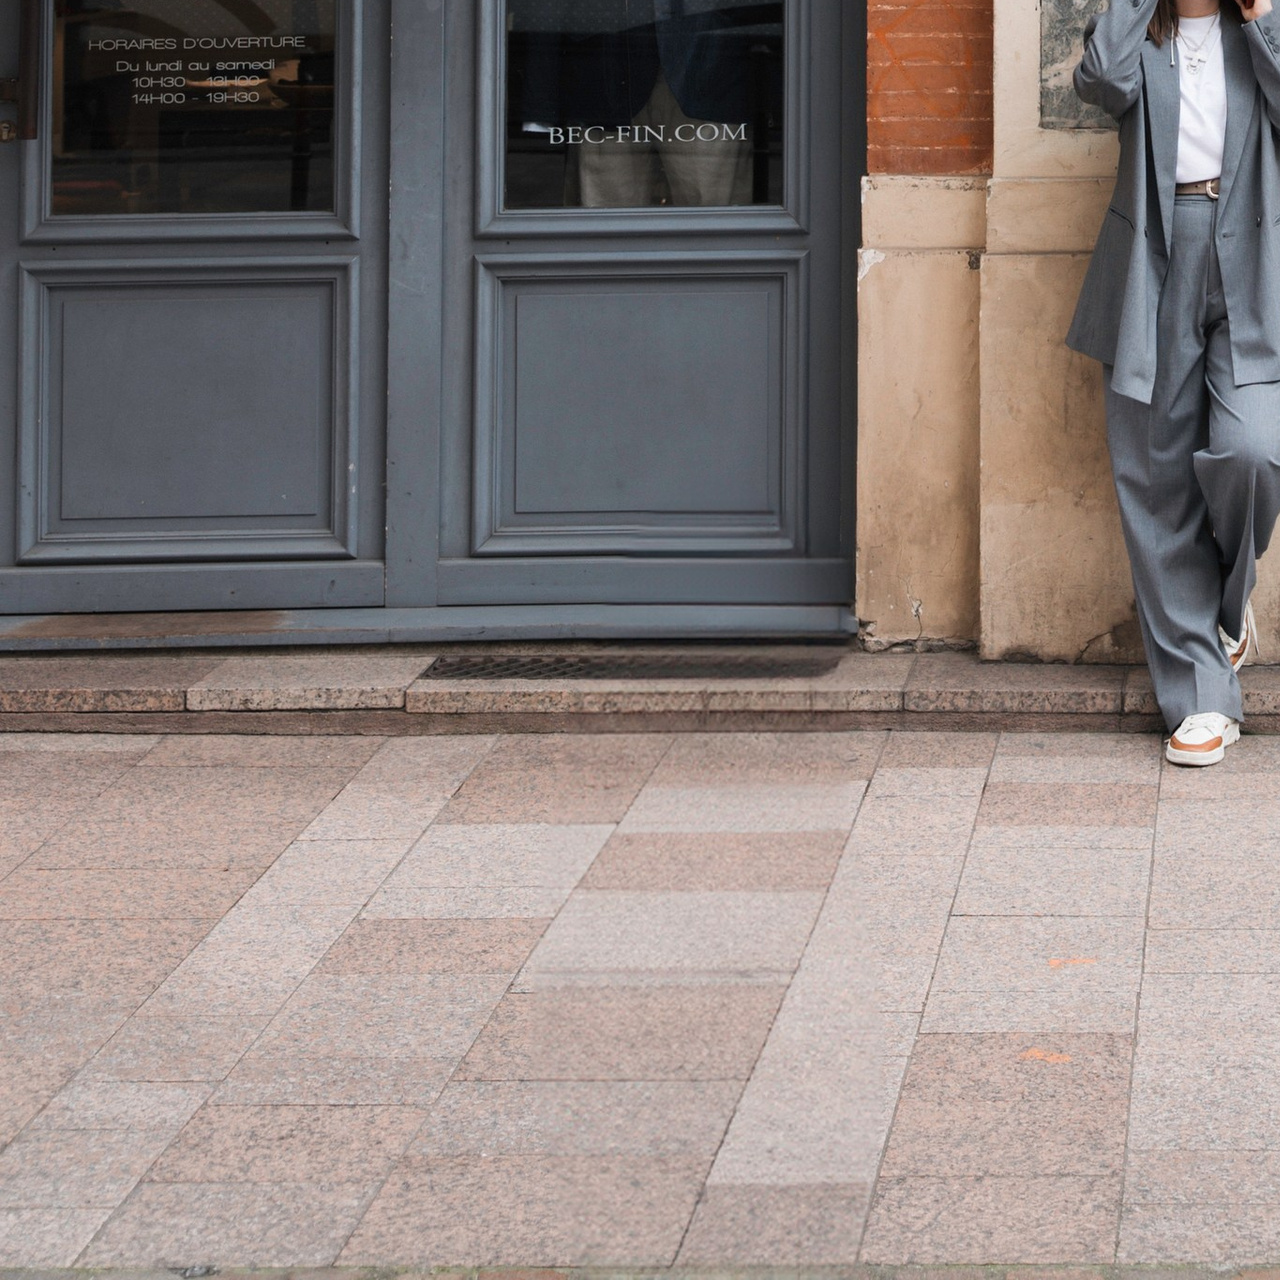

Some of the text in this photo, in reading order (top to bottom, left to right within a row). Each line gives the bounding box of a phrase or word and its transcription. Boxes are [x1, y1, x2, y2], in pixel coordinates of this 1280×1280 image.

[88, 36, 306, 51] HORAIRES D'OUVERTURE
[116, 58, 275, 72] Du lundi au samedi
[132, 77, 186, 88] 10H30
[132, 93, 186, 104] 14H00
[206, 92, 260, 103] 19H30
[548, 123, 748, 145] BEC-FIN.COM
